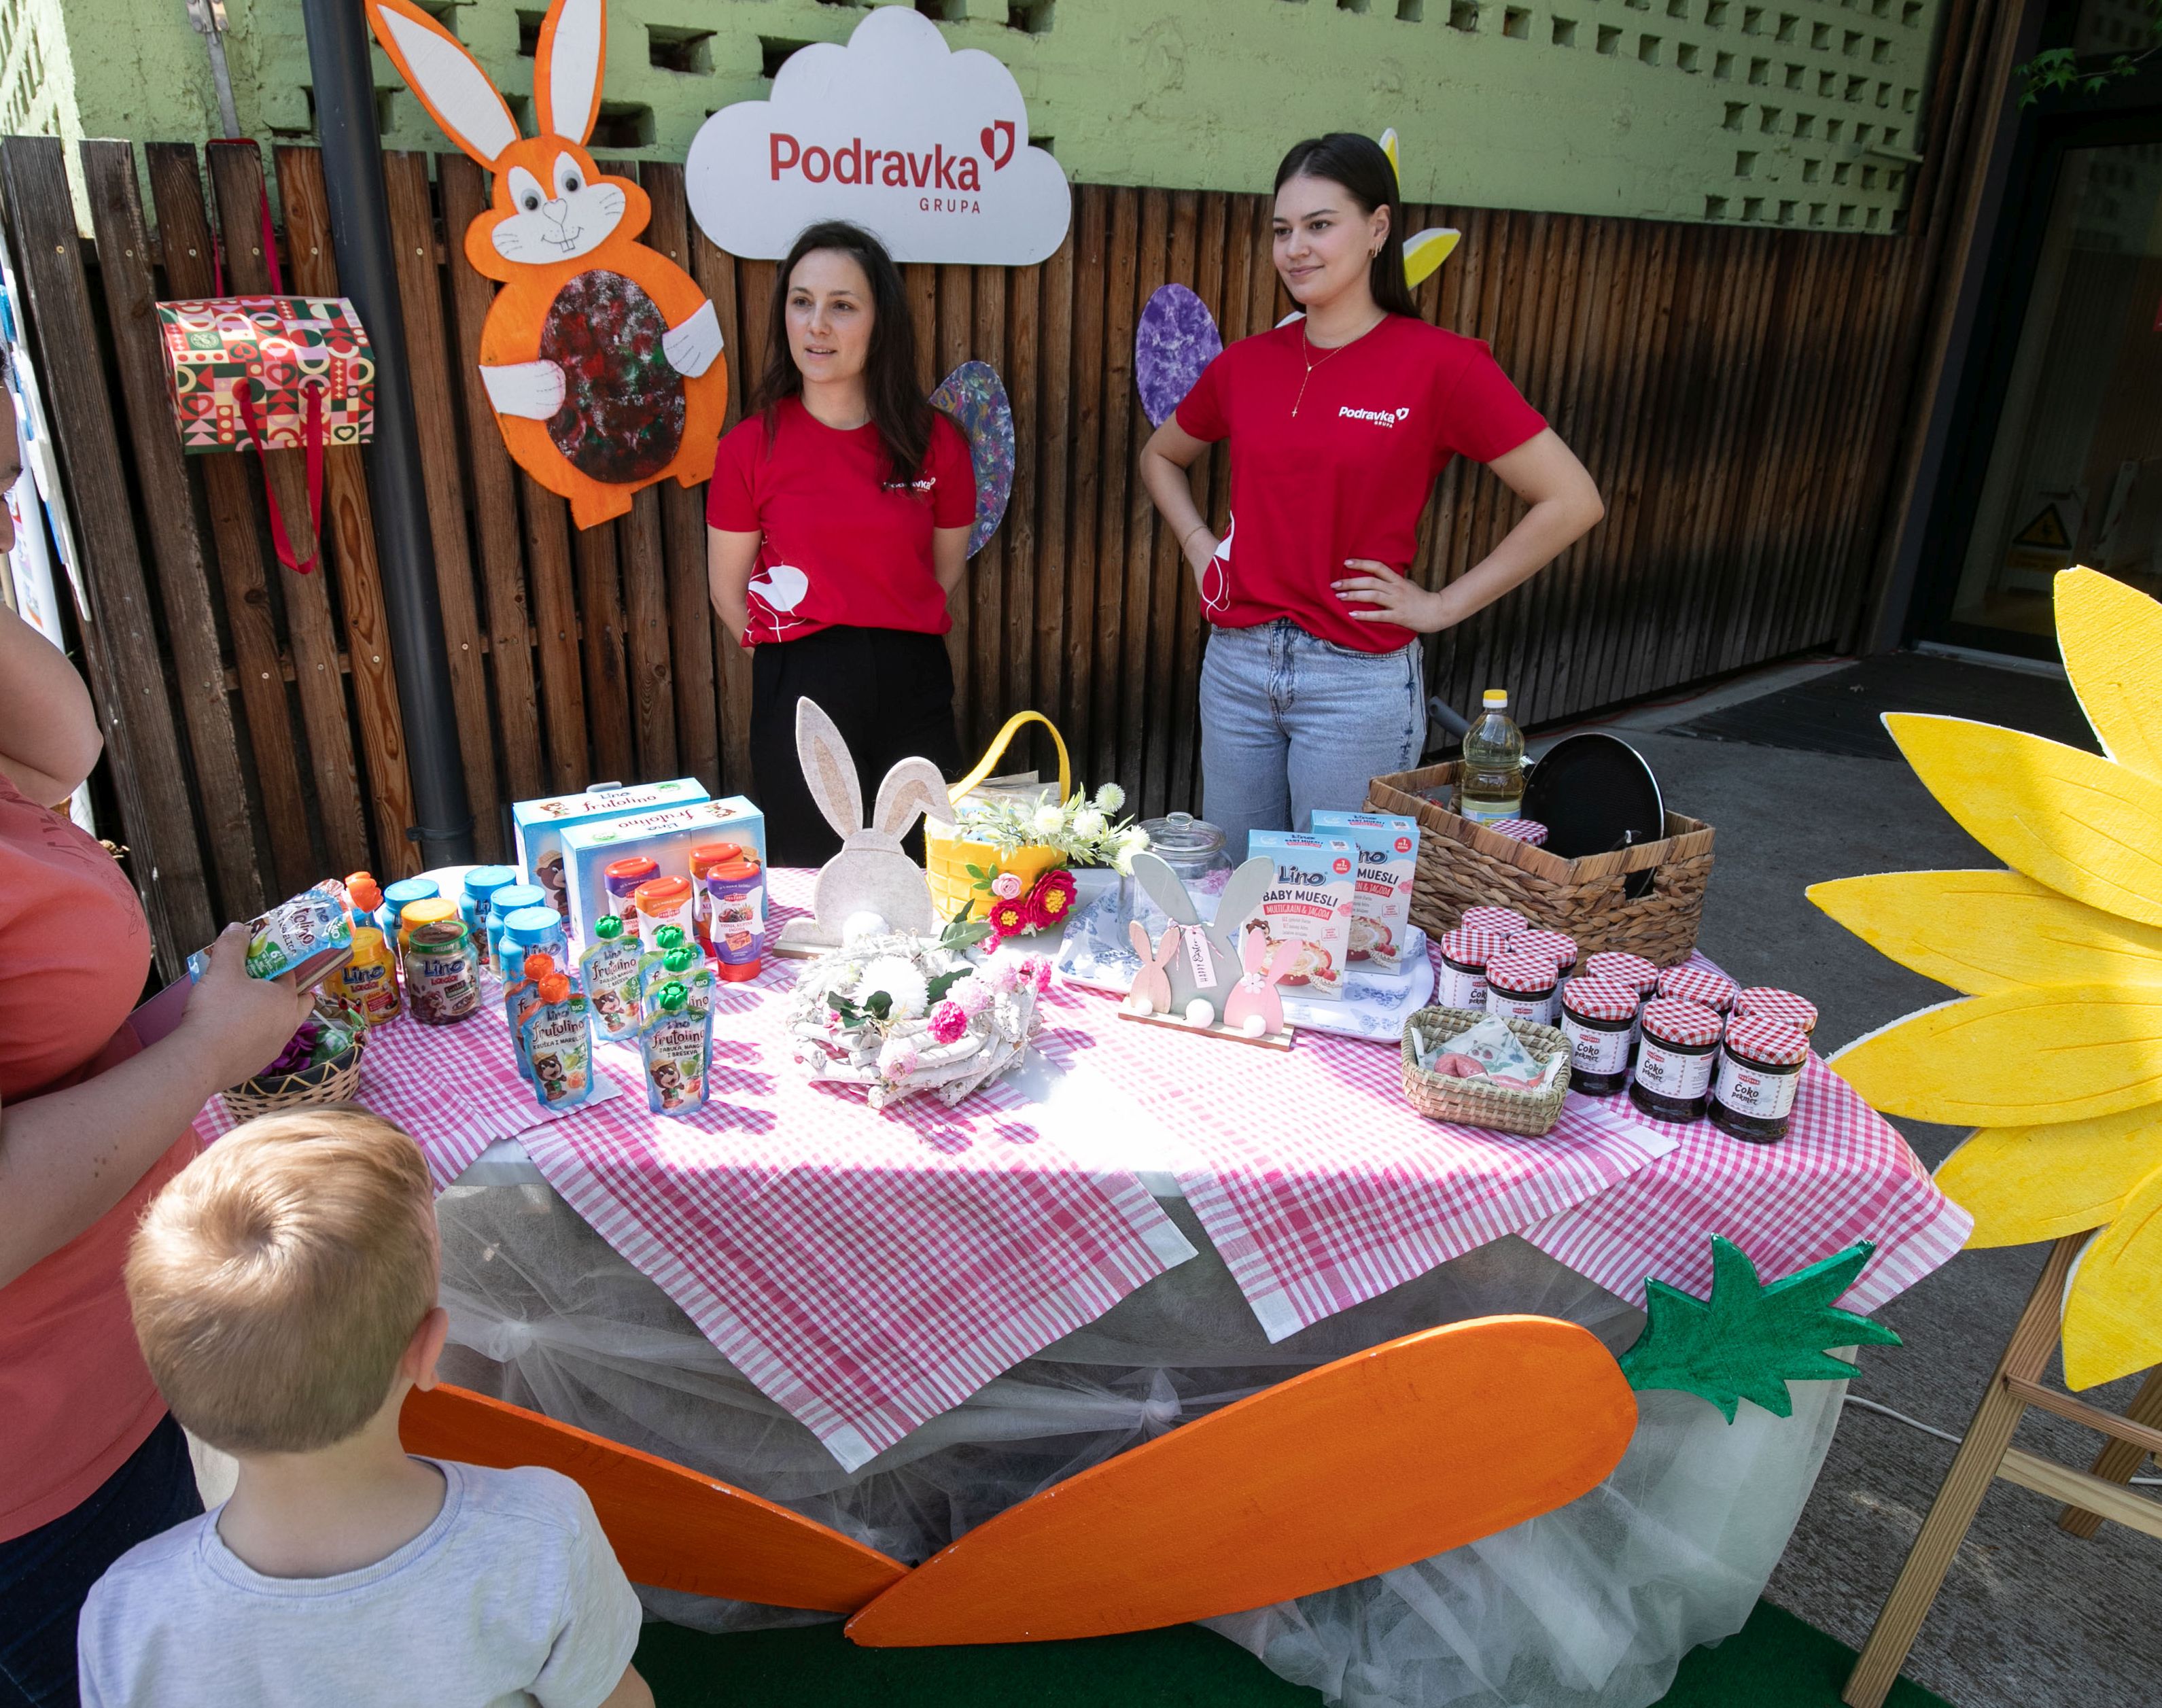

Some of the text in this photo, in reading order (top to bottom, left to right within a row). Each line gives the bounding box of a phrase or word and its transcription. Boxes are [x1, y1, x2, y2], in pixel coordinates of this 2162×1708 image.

[769, 133, 981, 192] Podravka
[920, 198, 981, 213] GRUPA
[1338, 406, 1395, 423] Podravka
[1374, 420, 1393, 428] GRUPA
[583, 795, 657, 812] frutolino
[618, 809, 694, 828] frutolino
[1358, 848, 1388, 865] no
[1278, 865, 1326, 886] Lino
[1357, 869, 1399, 885] MUESLI
[1263, 890, 1293, 902] BABY
[1295, 890, 1338, 907] MUESLI
[1370, 884, 1391, 896] JAGODA
[474, 899, 489, 916] Li
[1266, 904, 1301, 913] MULTIGRAIN
[1308, 907, 1332, 919] JAGODA
[432, 943, 455, 952] CREAMY
[423, 958, 466, 977] Lino
[1191, 937, 1208, 982] HAPPY Easter
[342, 966, 385, 984] Lino
[593, 959, 636, 980] frutolino
[547, 1008, 569, 1021] Lino
[532, 1020, 585, 1043] frutolino
[652, 1030, 705, 1049] frutolino
[533, 1041, 555, 1050] KRUŠKA
[1577, 1041, 1599, 1056] Čoko
[1575, 1051, 1599, 1062] pekmez
[1642, 1068, 1662, 1082] pekmez
[1644, 1058, 1664, 1075] Čoko
[1734, 1081, 1759, 1098] Čoko
[1731, 1092, 1758, 1105] pekmez
